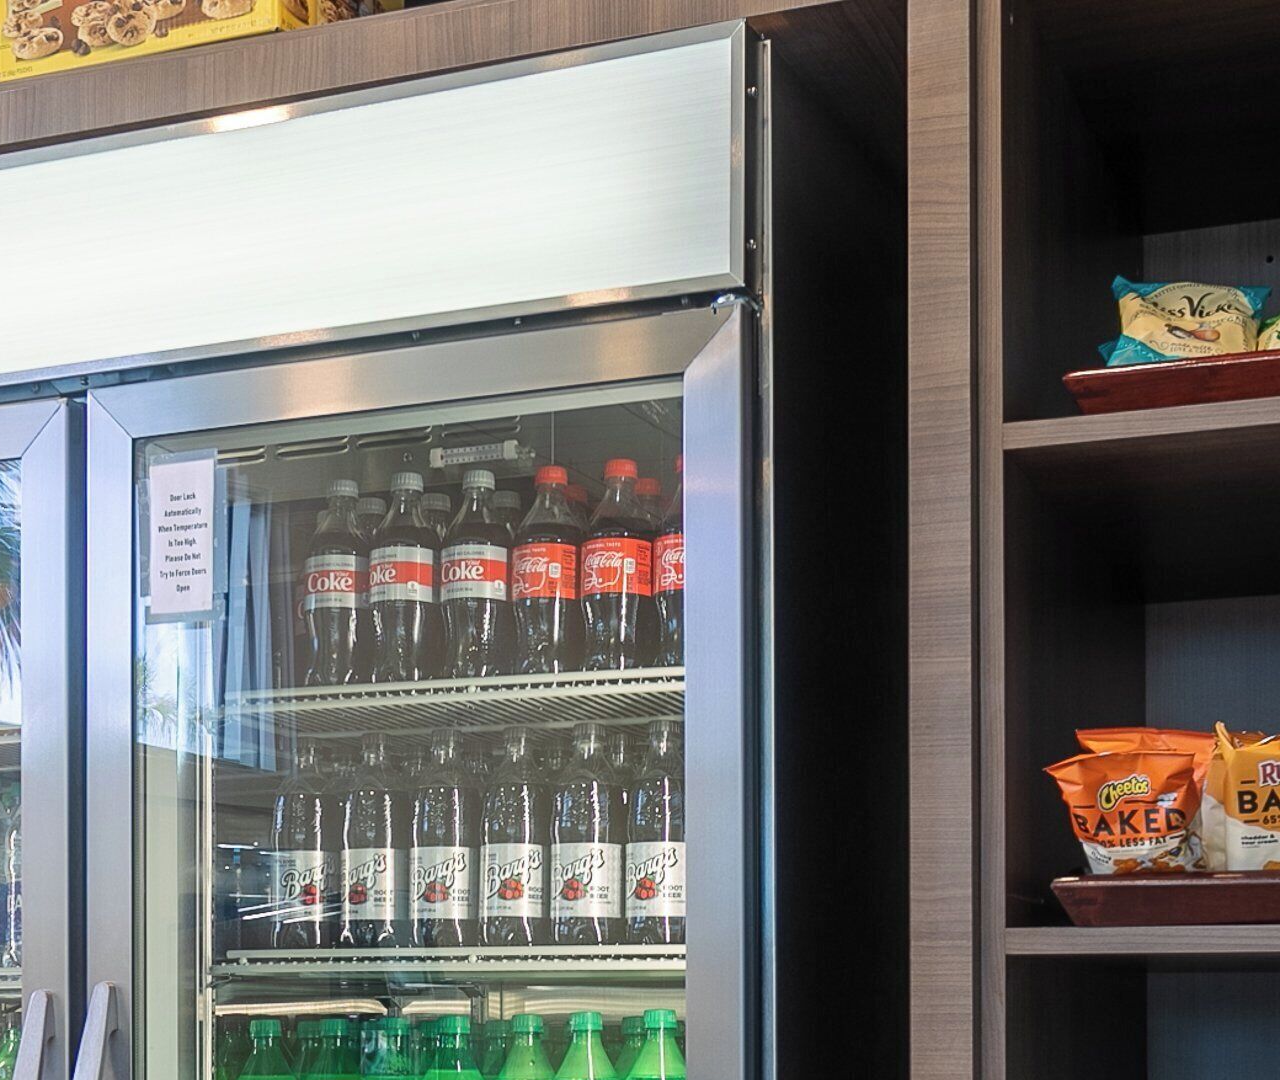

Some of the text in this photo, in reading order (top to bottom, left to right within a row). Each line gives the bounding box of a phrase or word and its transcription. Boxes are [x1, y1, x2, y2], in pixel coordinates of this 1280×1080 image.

[164, 507, 202, 518] Automatically
[158, 522, 208, 533] When Temperature
[165, 554, 183, 563] Please
[585, 551, 624, 568] Coca-Cola
[307, 571, 353, 593] Coke
[442, 561, 484, 582] Coke
[176, 584, 190, 593] Open
[1098, 775, 1151, 811] Cheetos
[1072, 807, 1187, 837] BAKED
[1119, 835, 1168, 849] LESS FAT
[281, 856, 336, 901] Barq's
[412, 853, 467, 902] Barq's
[487, 849, 542, 900] Barq's
[626, 848, 678, 900] Barq's
